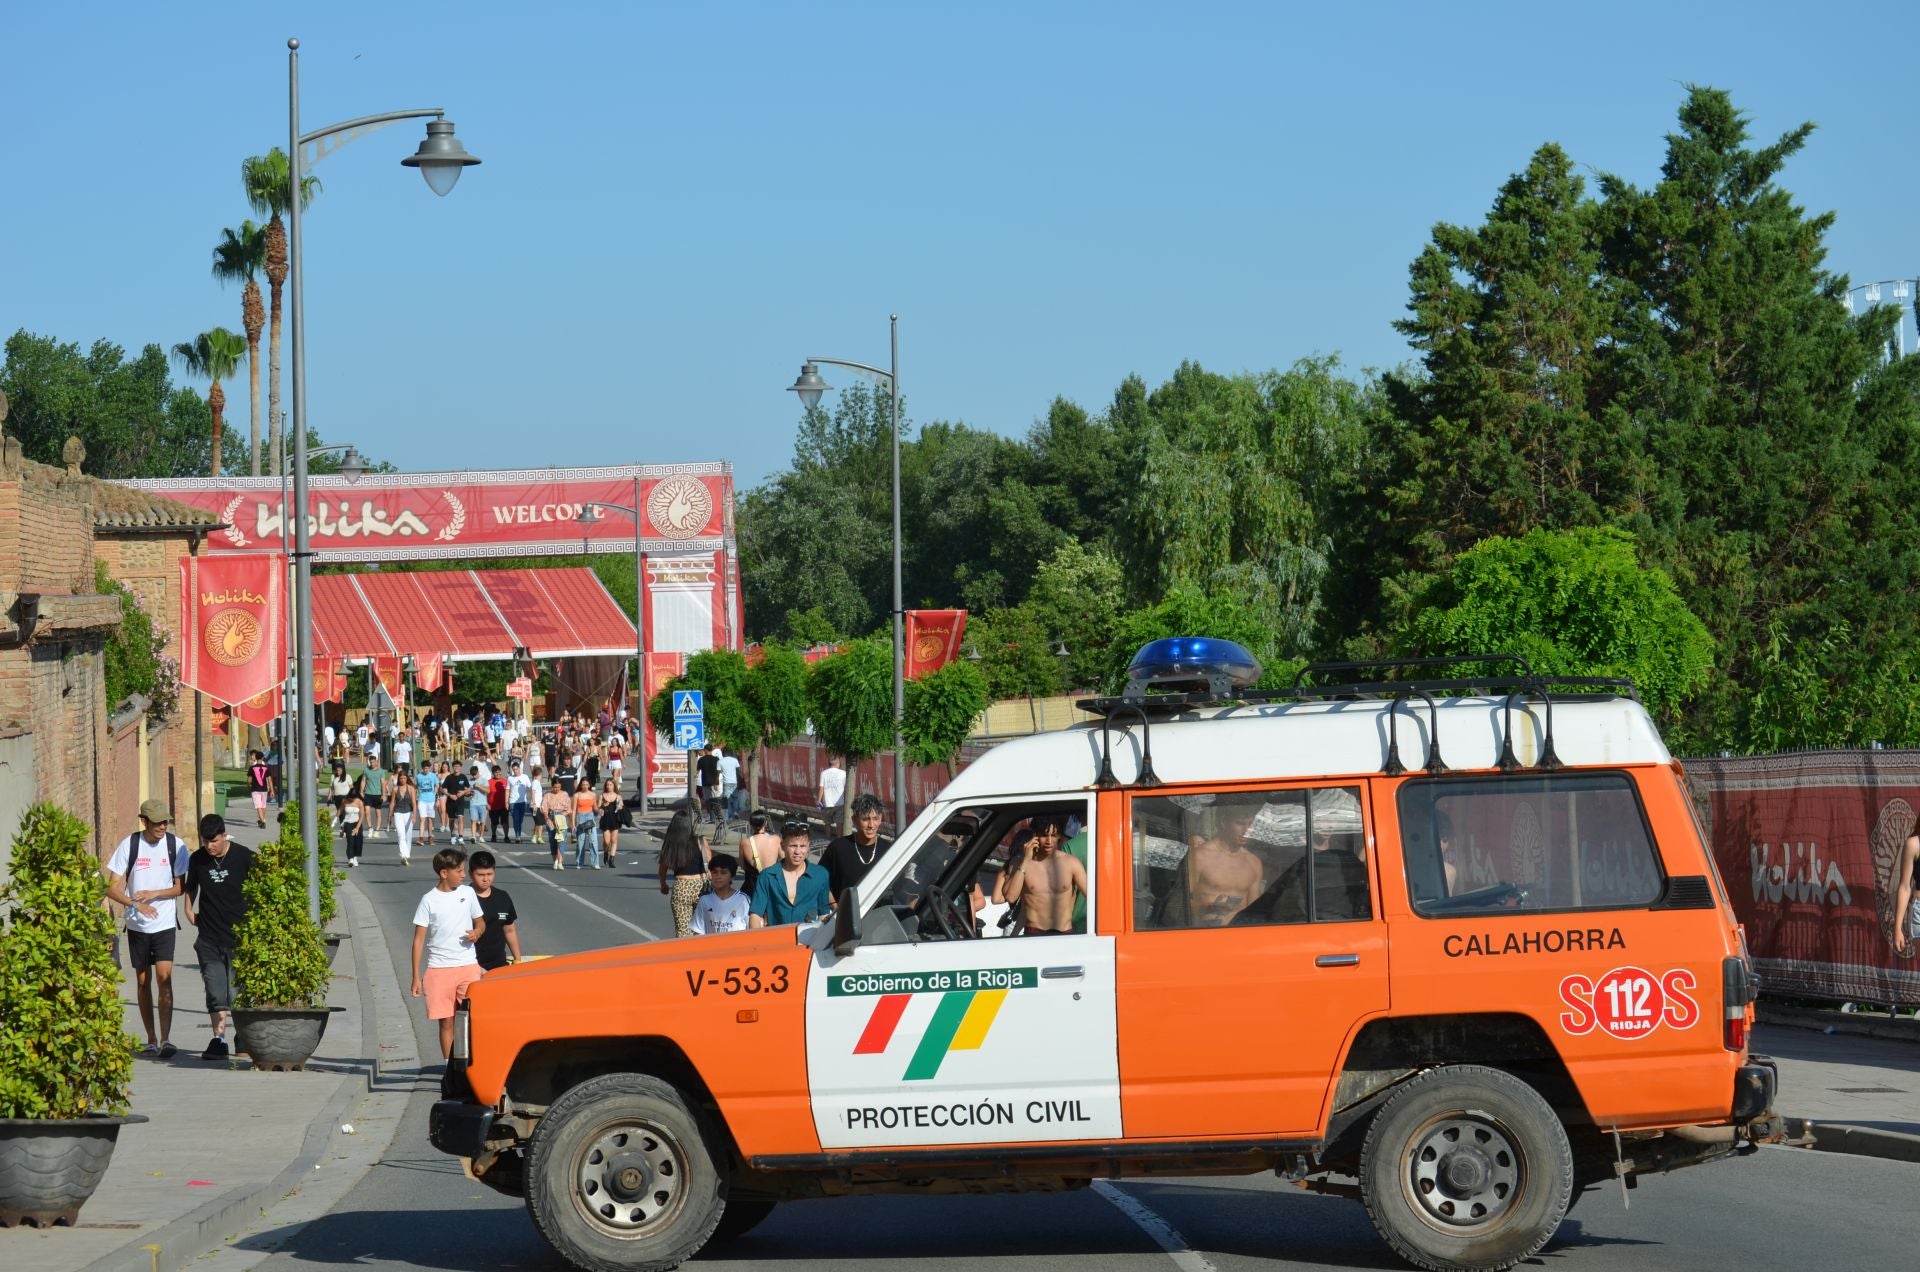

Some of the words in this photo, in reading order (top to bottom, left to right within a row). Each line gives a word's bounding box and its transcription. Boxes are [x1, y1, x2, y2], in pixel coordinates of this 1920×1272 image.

[1443, 927, 1626, 958] CALAHORRA
[686, 965, 789, 997] V-53.3
[841, 976, 924, 993] Gobierno
[928, 973, 950, 989] de
[956, 972, 972, 988] la
[978, 970, 1024, 989] Rioja
[1603, 977, 1652, 1018] 112
[1610, 1019, 1652, 1031] RIOJA
[846, 1098, 1014, 1130] PROTECCIÓN
[1026, 1100, 1091, 1124] CIVIL
